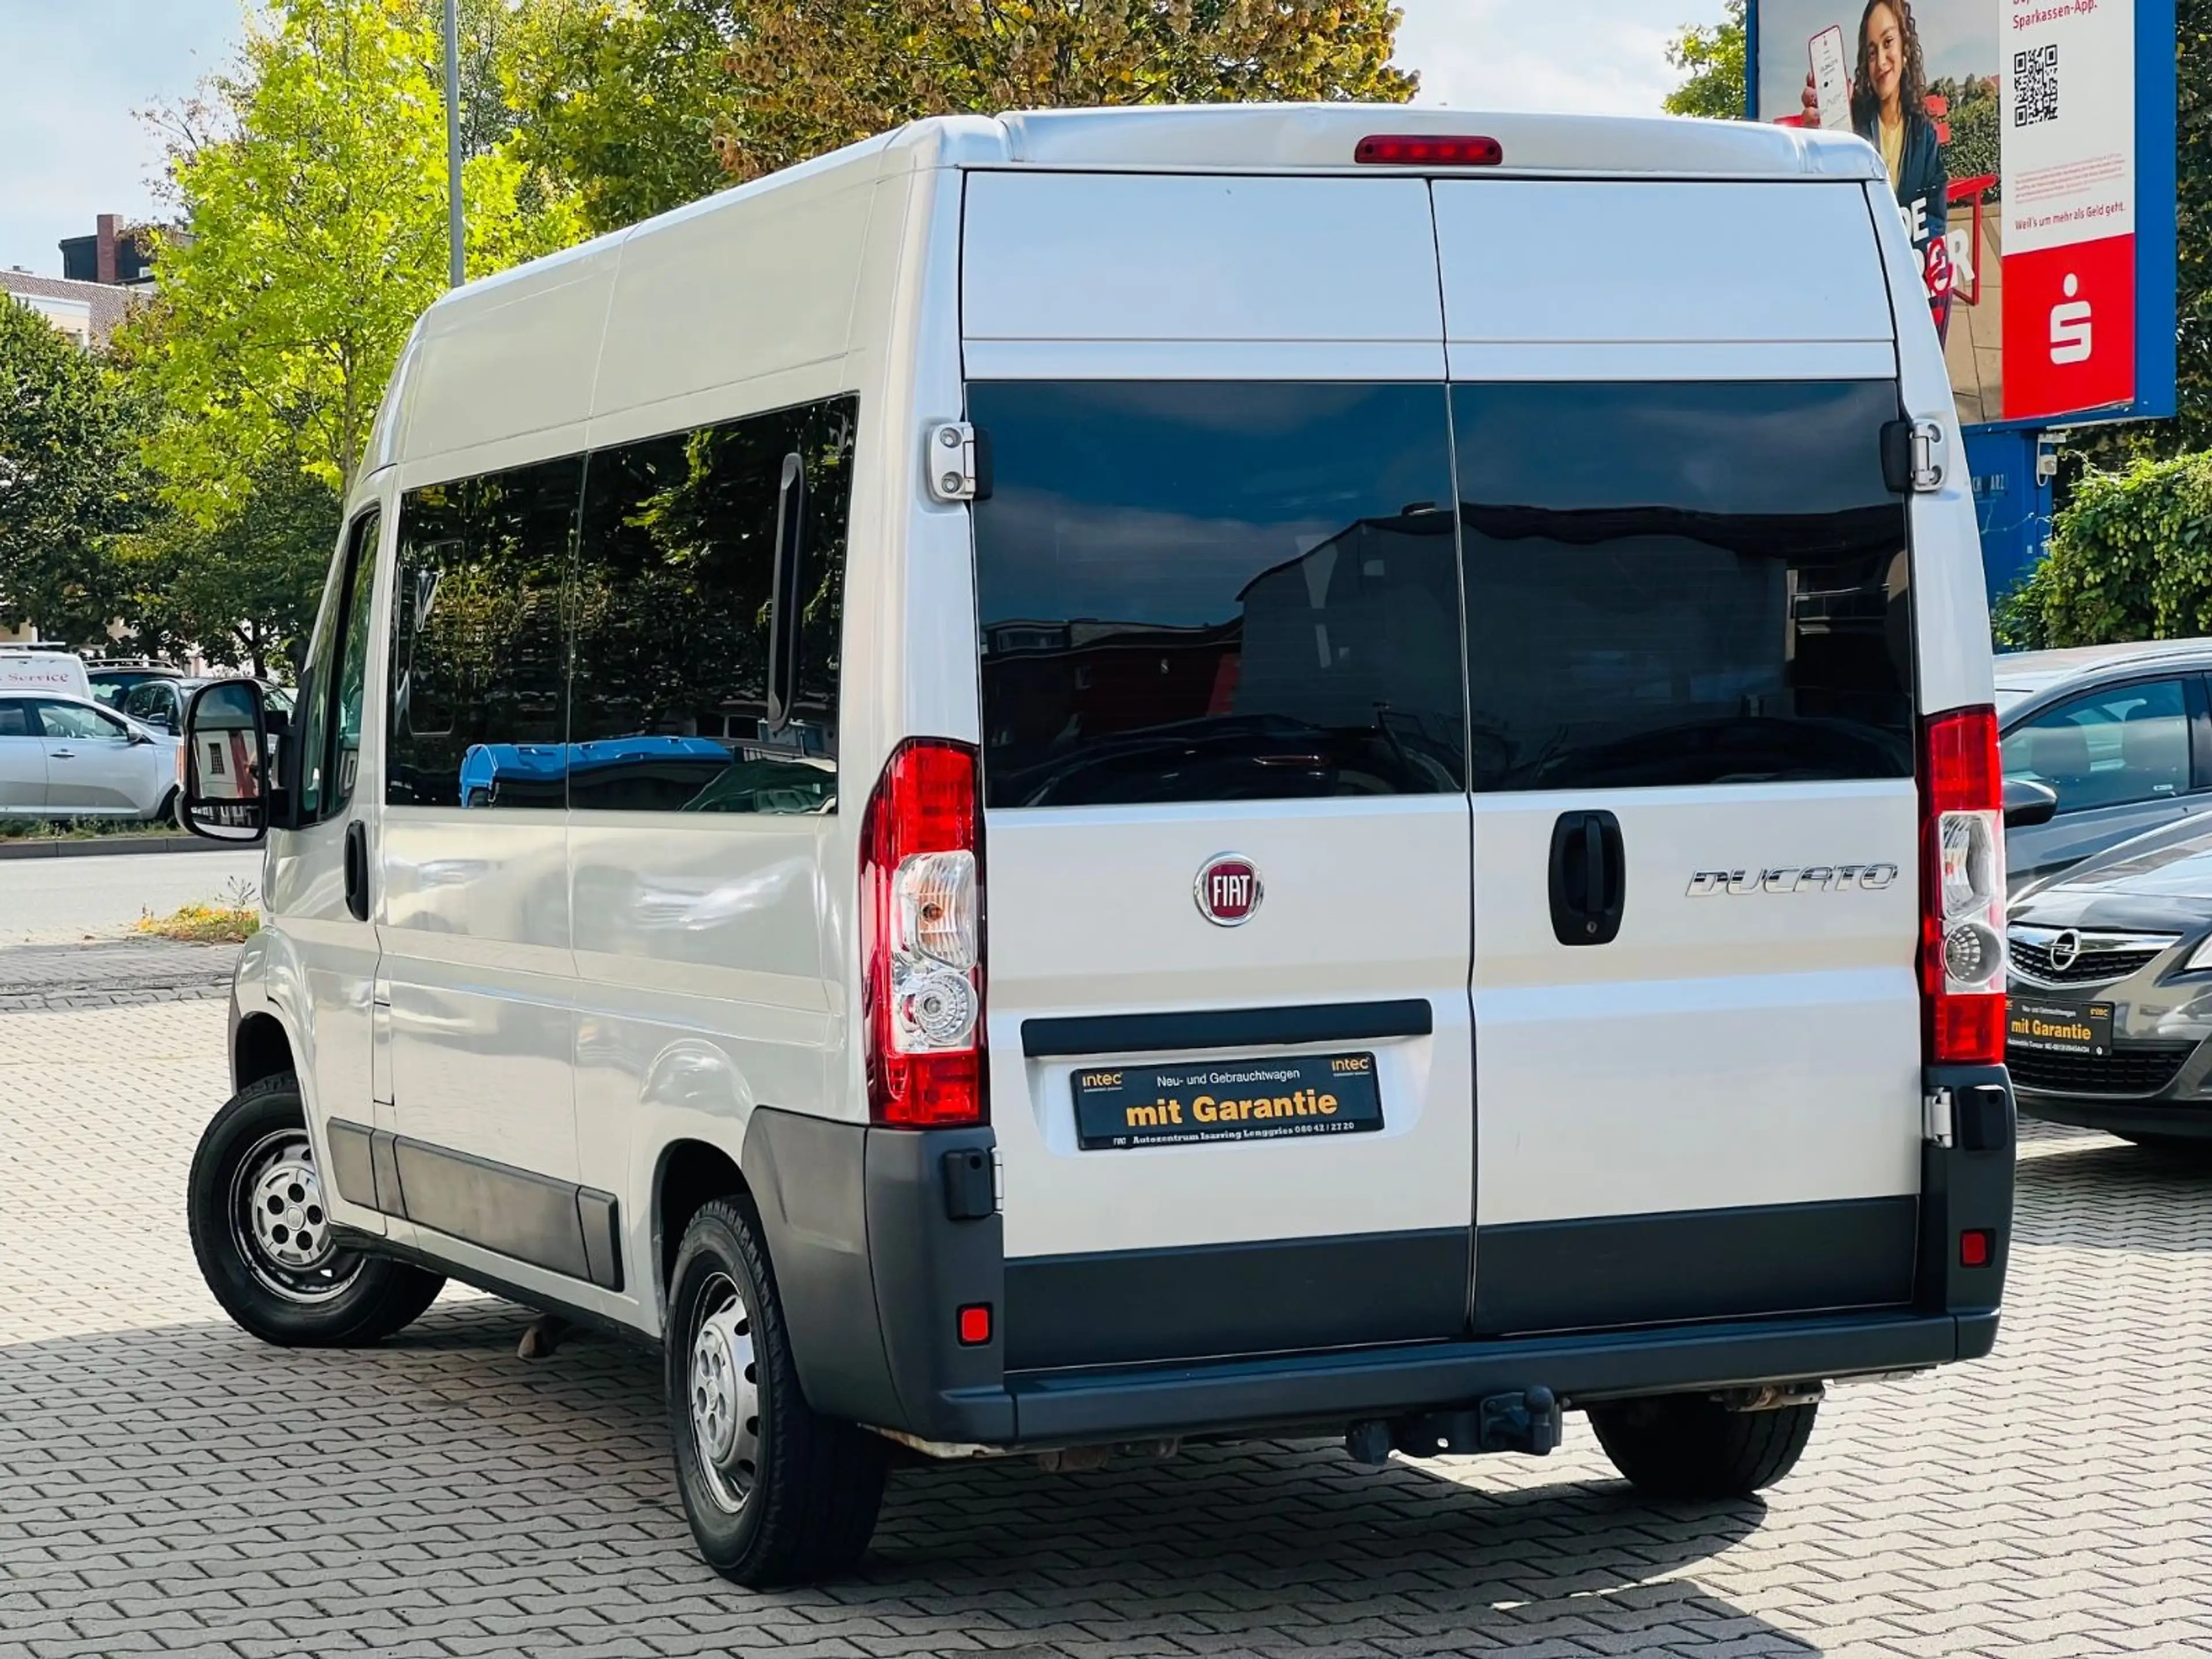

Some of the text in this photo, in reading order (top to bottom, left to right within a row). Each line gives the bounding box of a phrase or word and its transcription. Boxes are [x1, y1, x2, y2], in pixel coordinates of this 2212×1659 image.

[2013, 0, 2097, 30] Sparkassen-App.
[2039, 217, 2051, 226] um
[2053, 211, 2072, 224] mehr
[2074, 207, 2085, 219] als
[2086, 204, 2104, 217] Geld
[1213, 875, 1251, 907] FIAT
[1685, 863, 1898, 897] DUCATO
[2011, 1018, 2092, 1041] mit Garantie
[1331, 1058, 1369, 1071] intec
[1082, 1073, 1123, 1087] intec
[1157, 1069, 1300, 1088] Neu- und Gebrauchtwagen
[1126, 1089, 1338, 1127] mit Garantie
